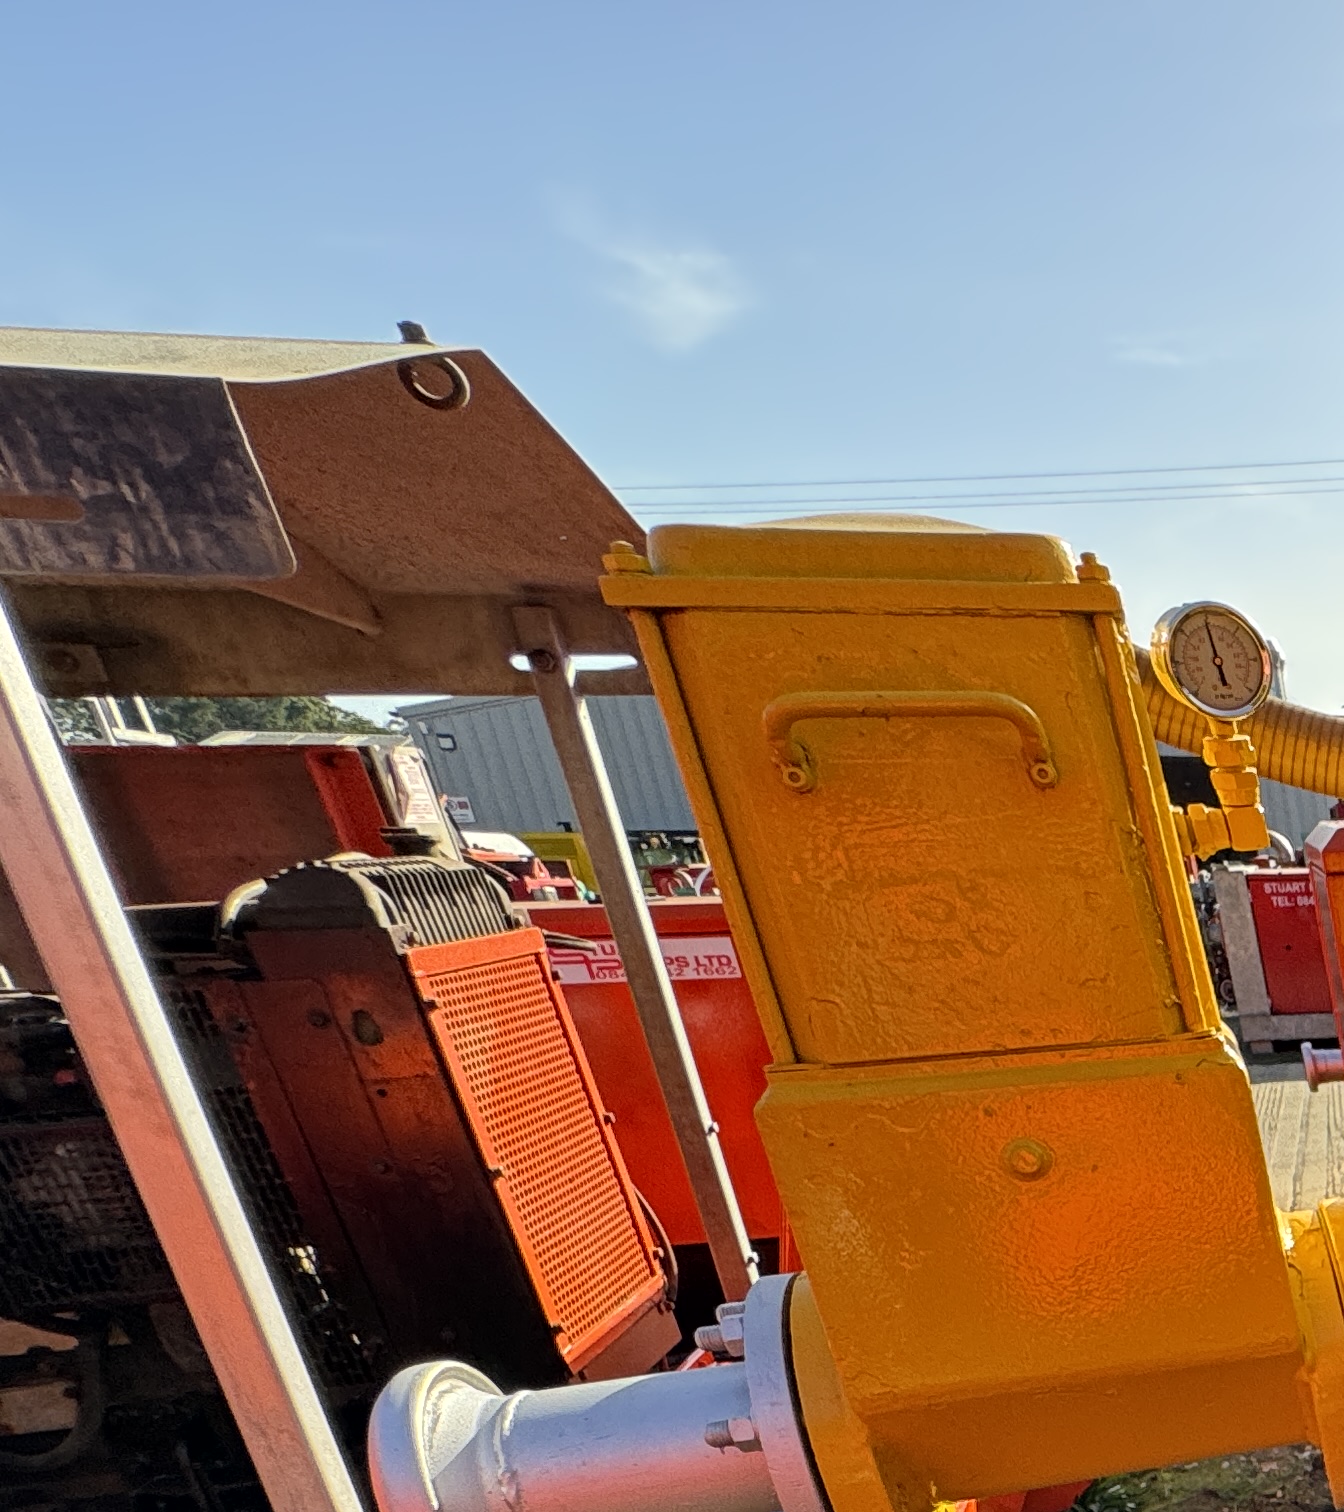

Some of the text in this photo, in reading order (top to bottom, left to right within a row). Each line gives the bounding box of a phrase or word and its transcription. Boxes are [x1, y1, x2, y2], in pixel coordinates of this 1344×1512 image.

[1263, 881, 1306, 895] STUART
[693, 954, 732, 967] LTD
[692, 965, 738, 976] 1662
